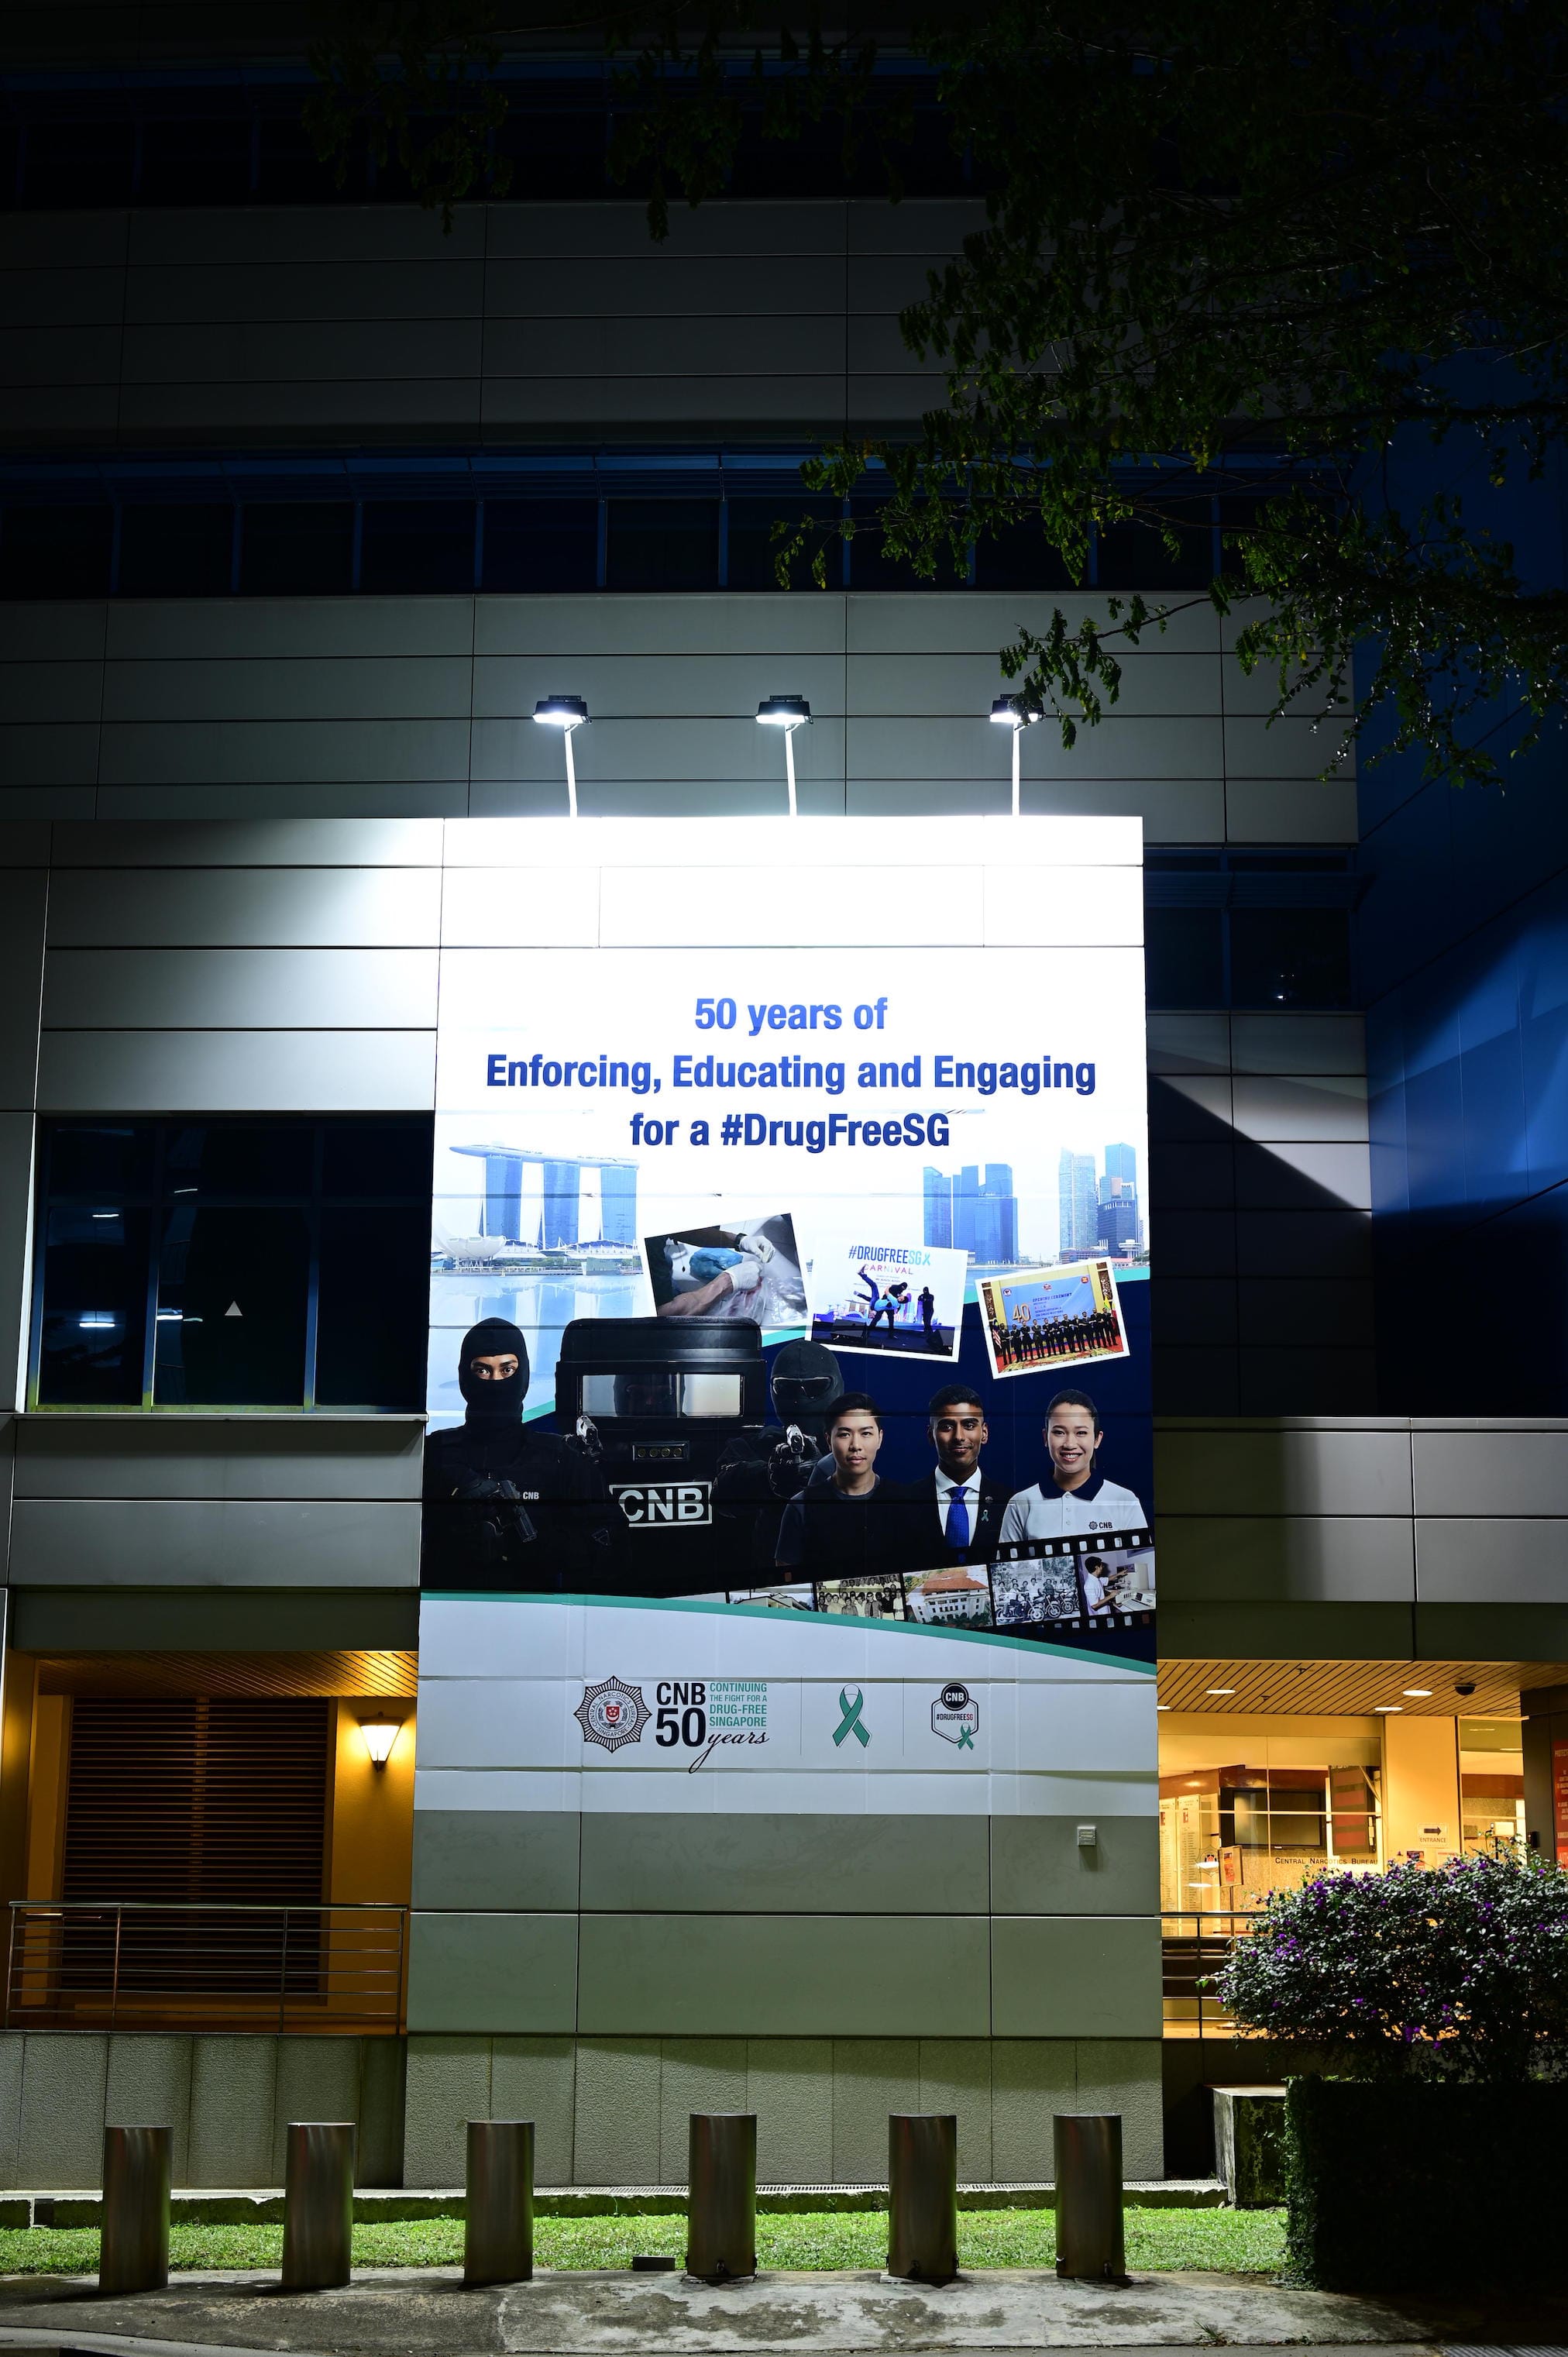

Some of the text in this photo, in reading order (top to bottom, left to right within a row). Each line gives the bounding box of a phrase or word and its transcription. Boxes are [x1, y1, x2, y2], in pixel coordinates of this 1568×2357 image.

[694, 996, 889, 1037] 50 years of
[487, 1054, 1096, 1096] Enforcing, Educating and Engaging
[629, 1112, 950, 1154] for a #DrugFreeSG
[1013, 1302, 1031, 1323] 40
[522, 1492, 540, 1500] CNB
[618, 1488, 704, 1522] CNB
[656, 1681, 707, 1705] CNB
[710, 1682, 768, 1692] CONTINUING
[598, 1691, 632, 1705] NARCOTICS
[945, 1692, 965, 1702] CNB
[710, 1704, 768, 1715] DRUG-FREE
[709, 1716, 767, 1727] SINGAPORE
[597, 1728, 628, 1737] SINGAPORE
[655, 1707, 770, 1774] 50 years
